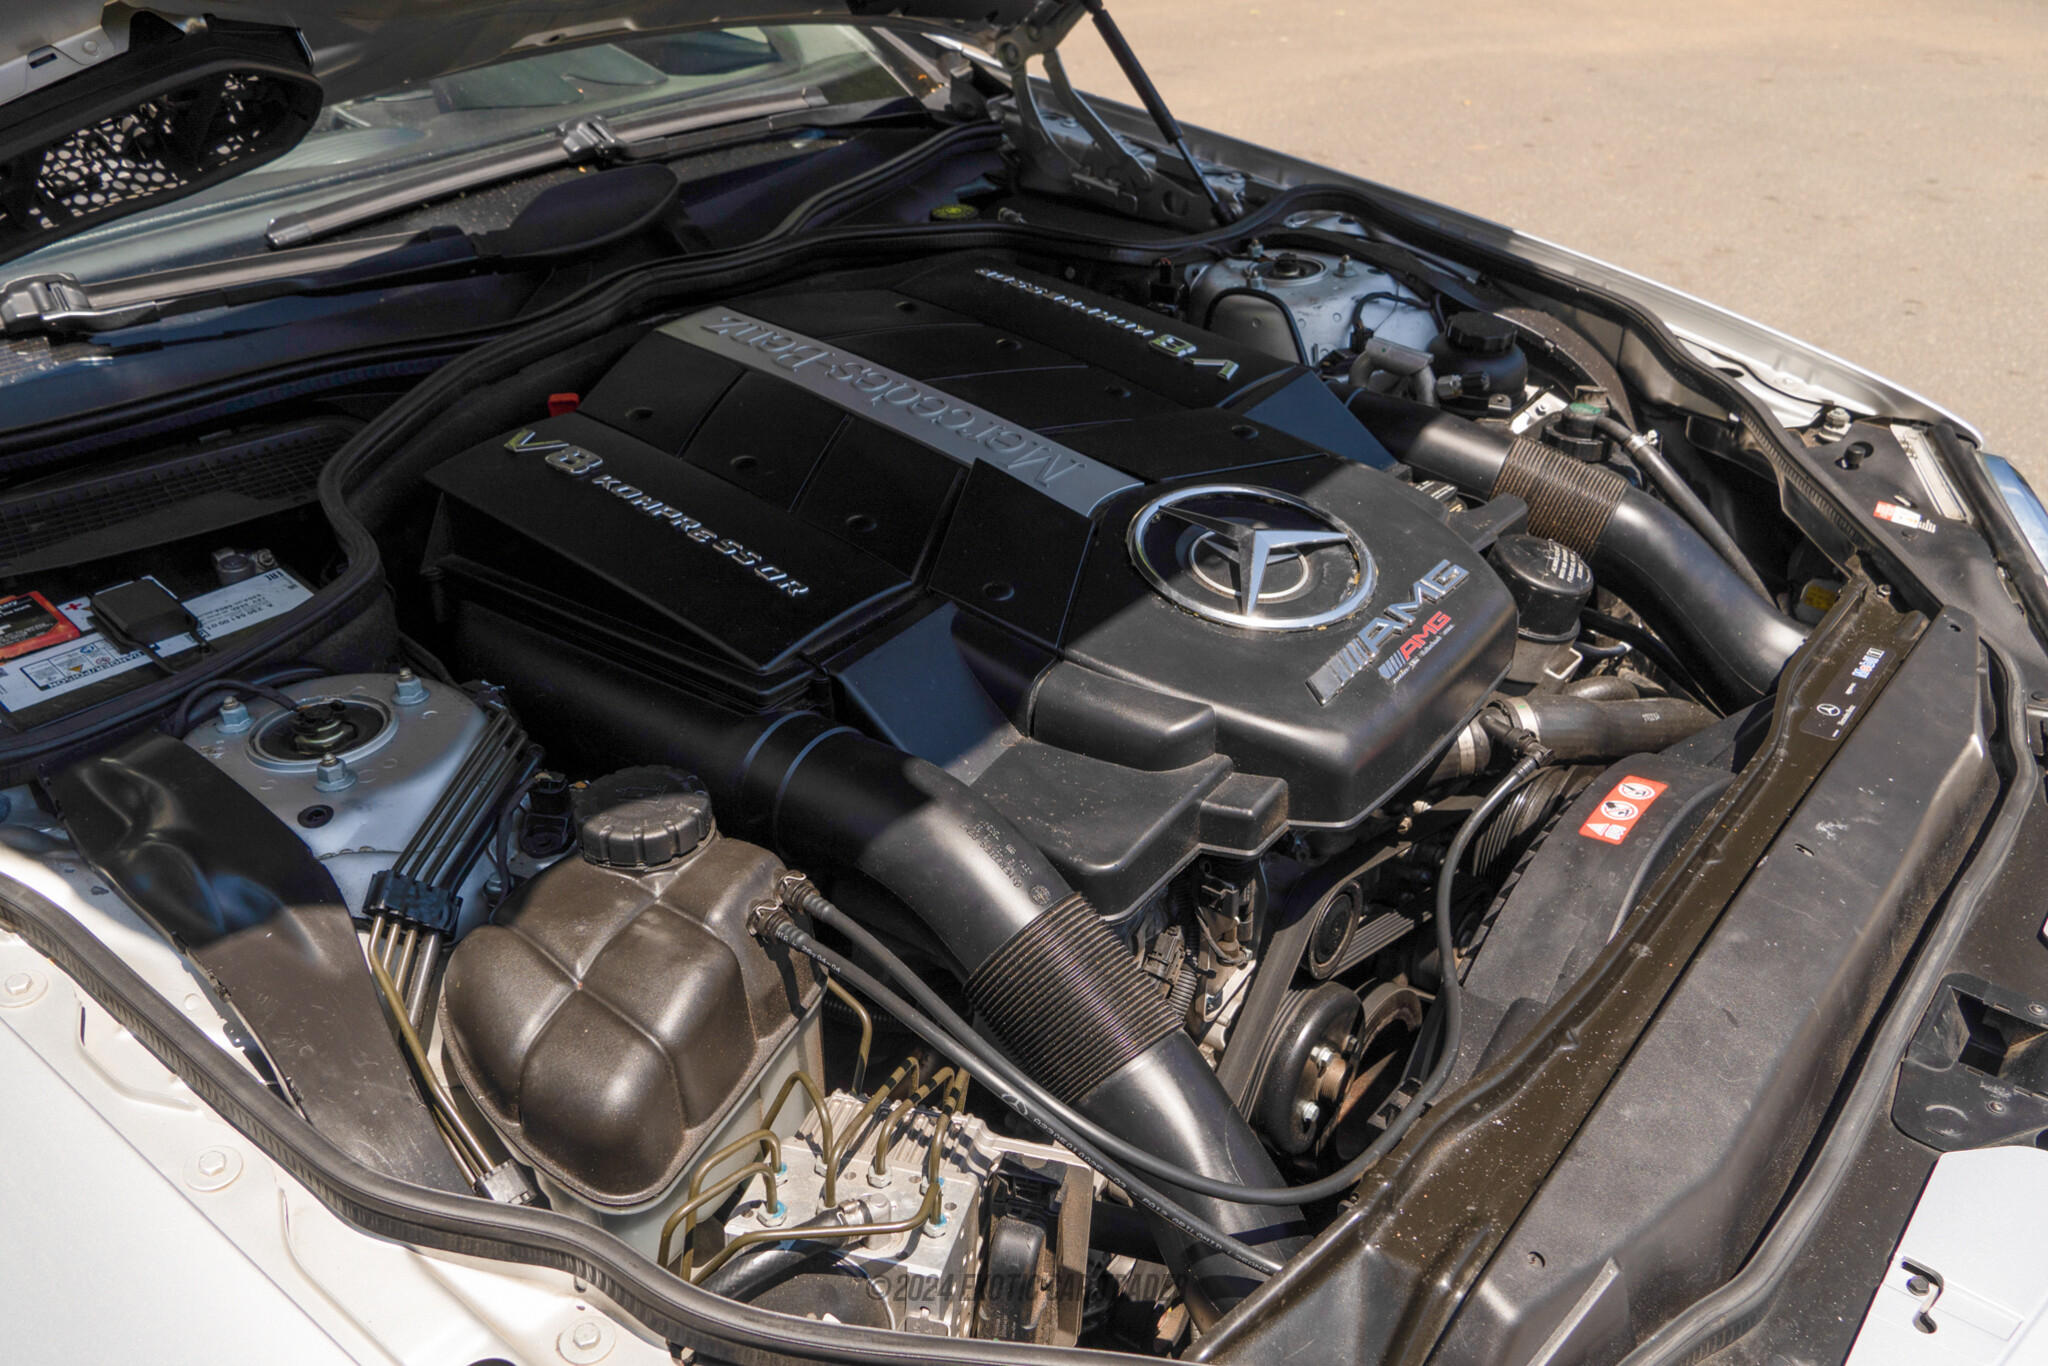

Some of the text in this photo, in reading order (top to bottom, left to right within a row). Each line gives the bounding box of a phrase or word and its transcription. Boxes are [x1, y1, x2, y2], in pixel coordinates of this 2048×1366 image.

[700, 315, 1087, 489] Mercedes-Benz
[1149, 334, 1239, 382] V8
[503, 429, 809, 598] V8 KOMPRESSOR
[1356, 559, 1470, 659] AMG
[1400, 610, 1452, 662] AMG
